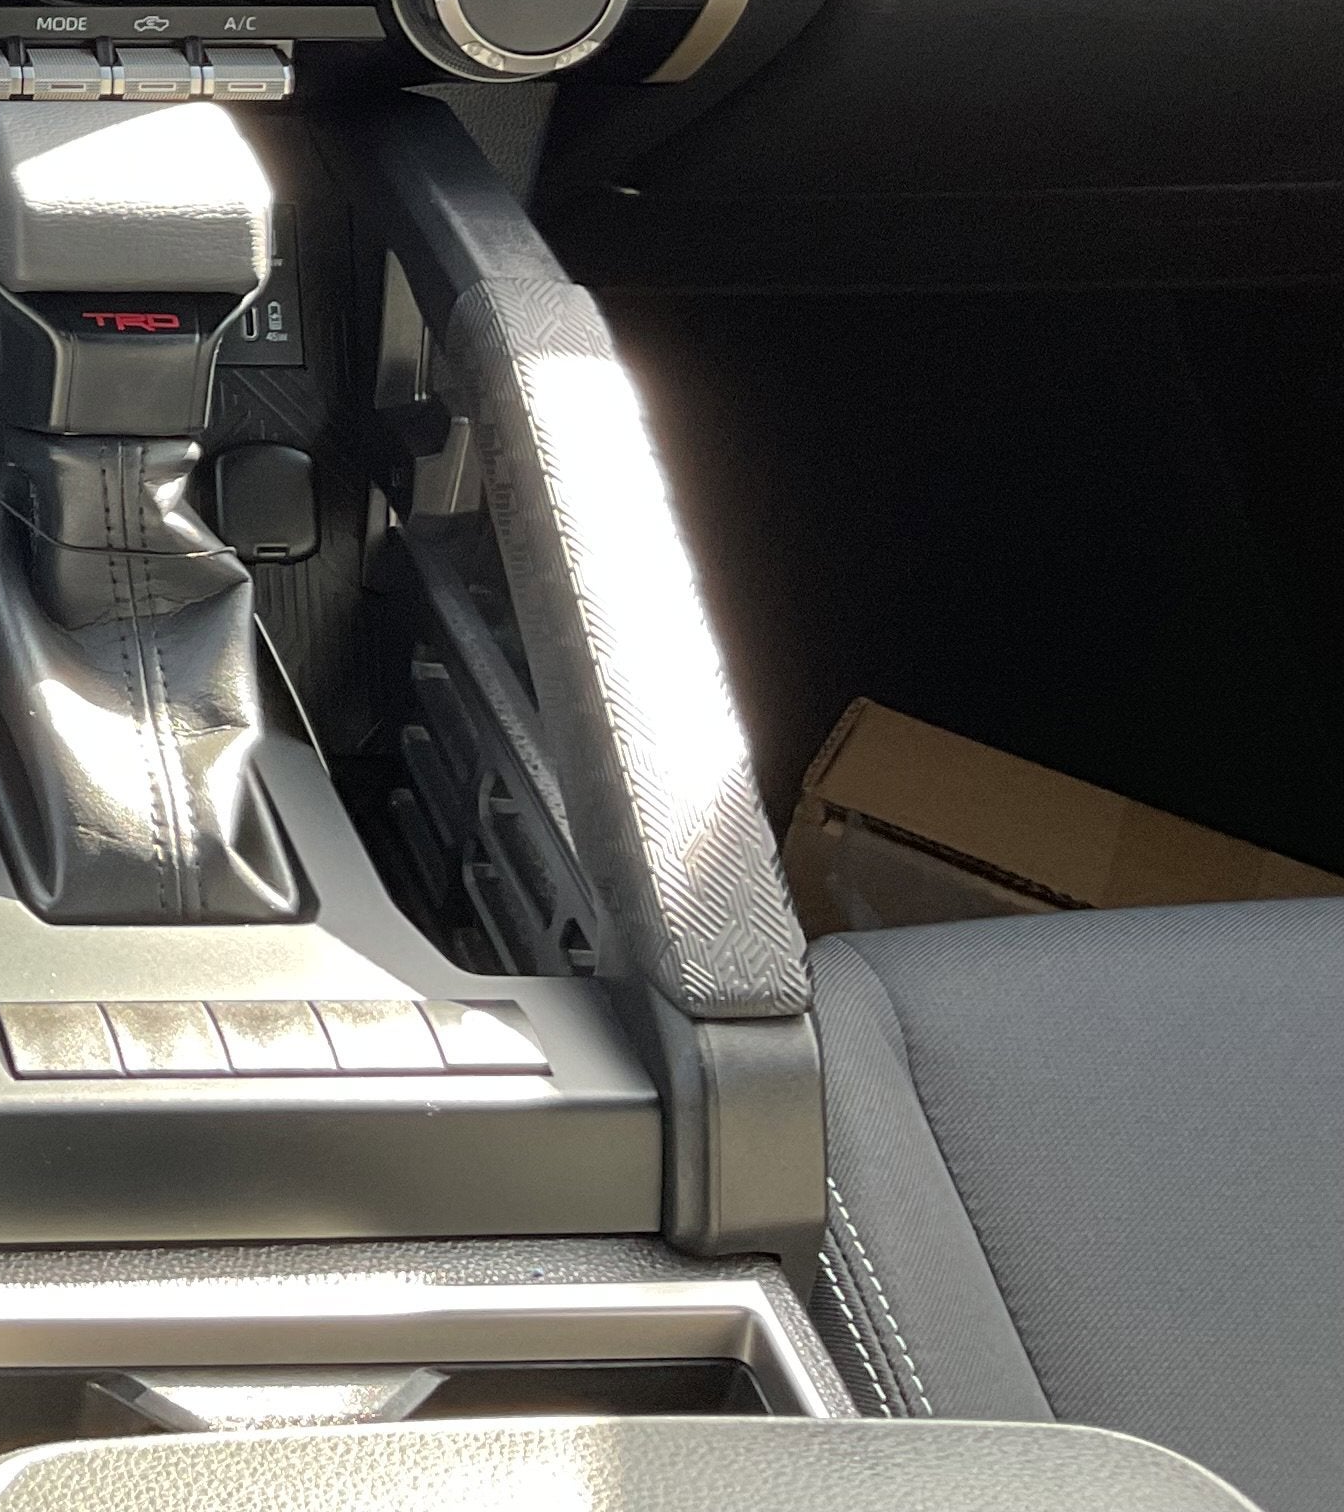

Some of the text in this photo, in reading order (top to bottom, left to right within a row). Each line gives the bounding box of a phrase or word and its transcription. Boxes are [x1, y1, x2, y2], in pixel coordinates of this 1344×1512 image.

[36, 17, 87, 31] MODE
[224, 15, 257, 32] A/C
[82, 312, 180, 332] TRD
